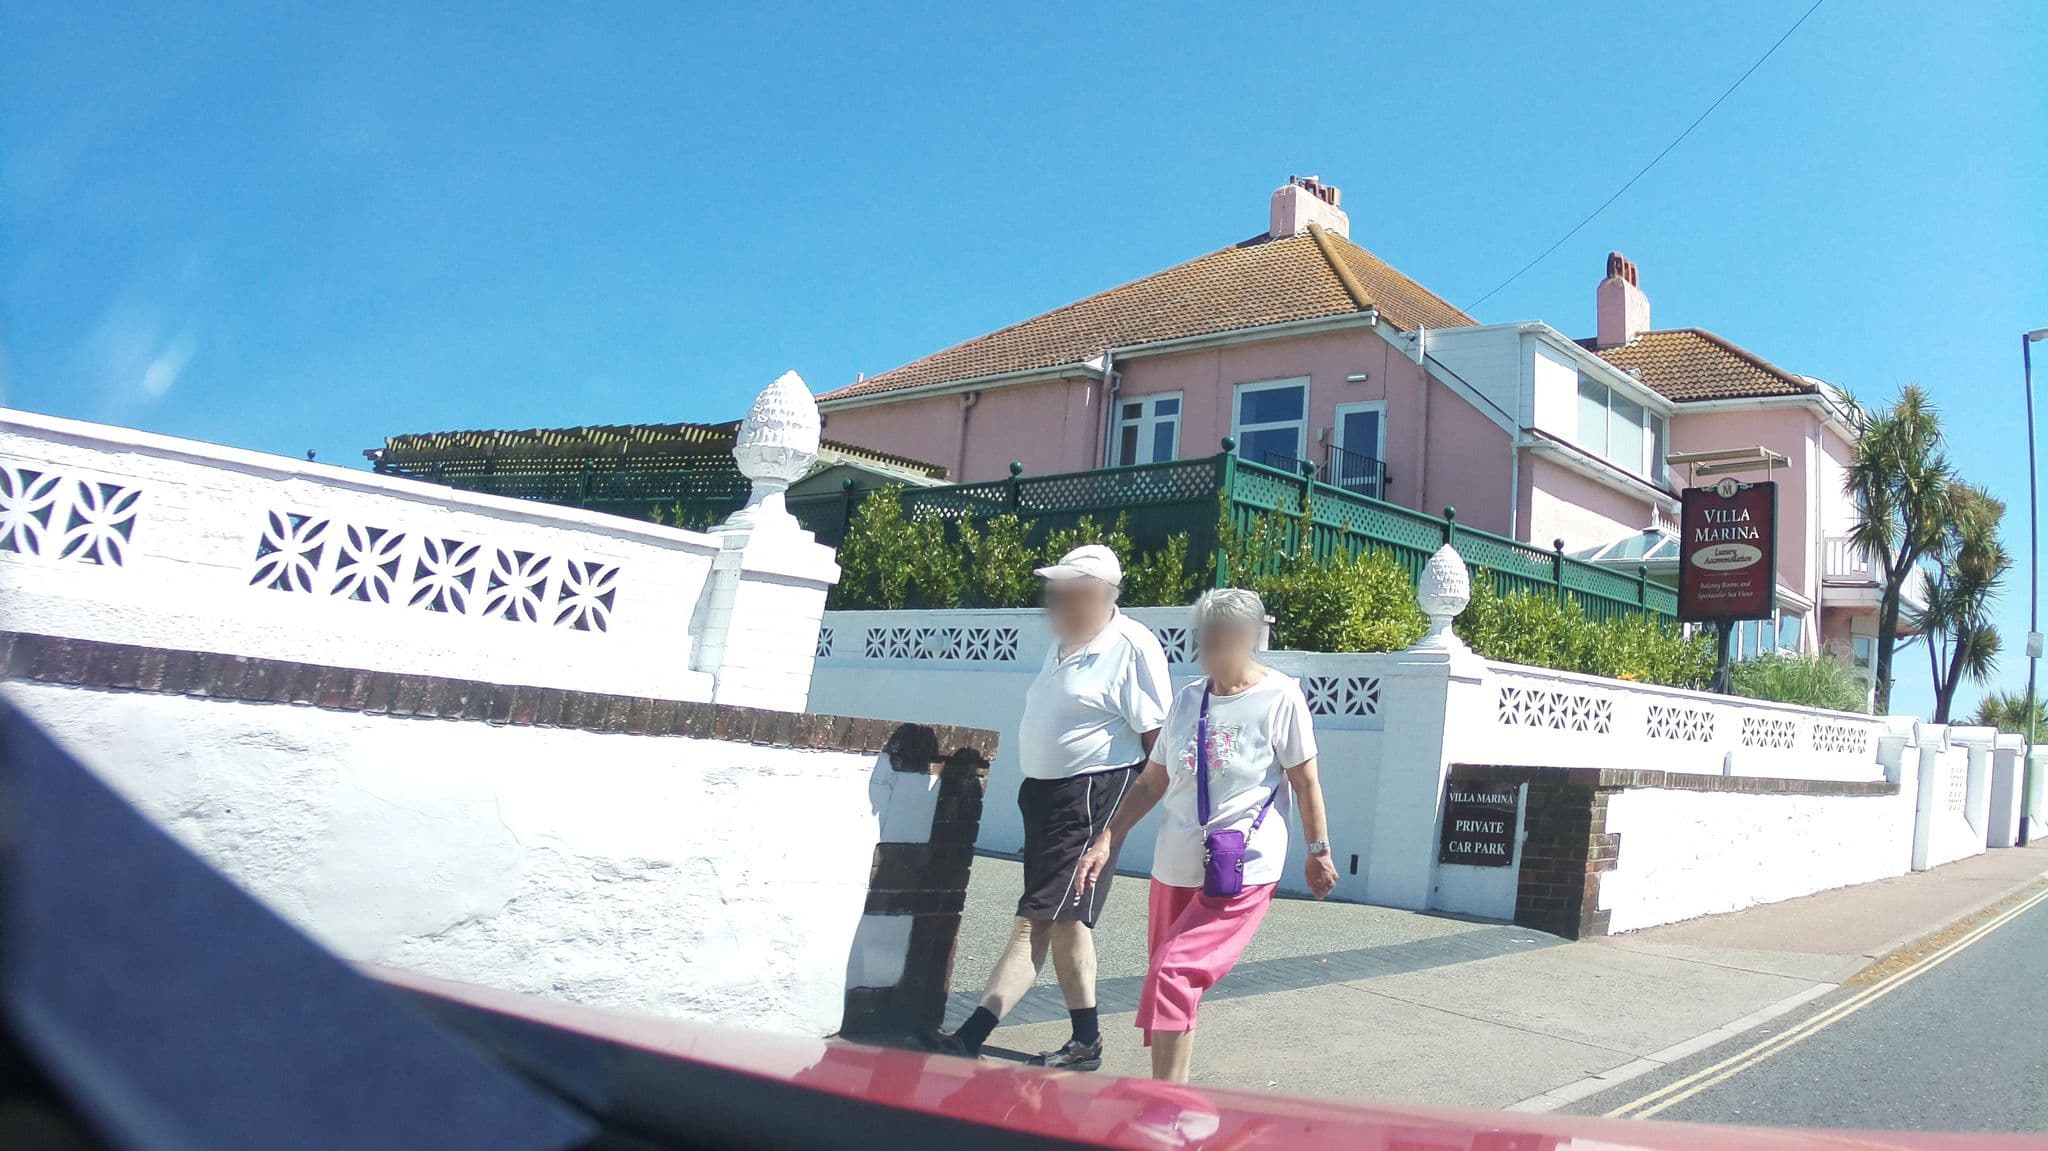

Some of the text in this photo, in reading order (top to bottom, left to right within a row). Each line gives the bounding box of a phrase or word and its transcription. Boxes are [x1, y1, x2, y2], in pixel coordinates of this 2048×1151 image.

[1704, 508, 1751, 523] VILLA
[1695, 526, 1760, 542] MARINA
[1449, 792, 1514, 804] VILLA MARINA
[1455, 820, 1505, 834] PRIVATE
[1449, 840, 1506, 855] CAR PARK
